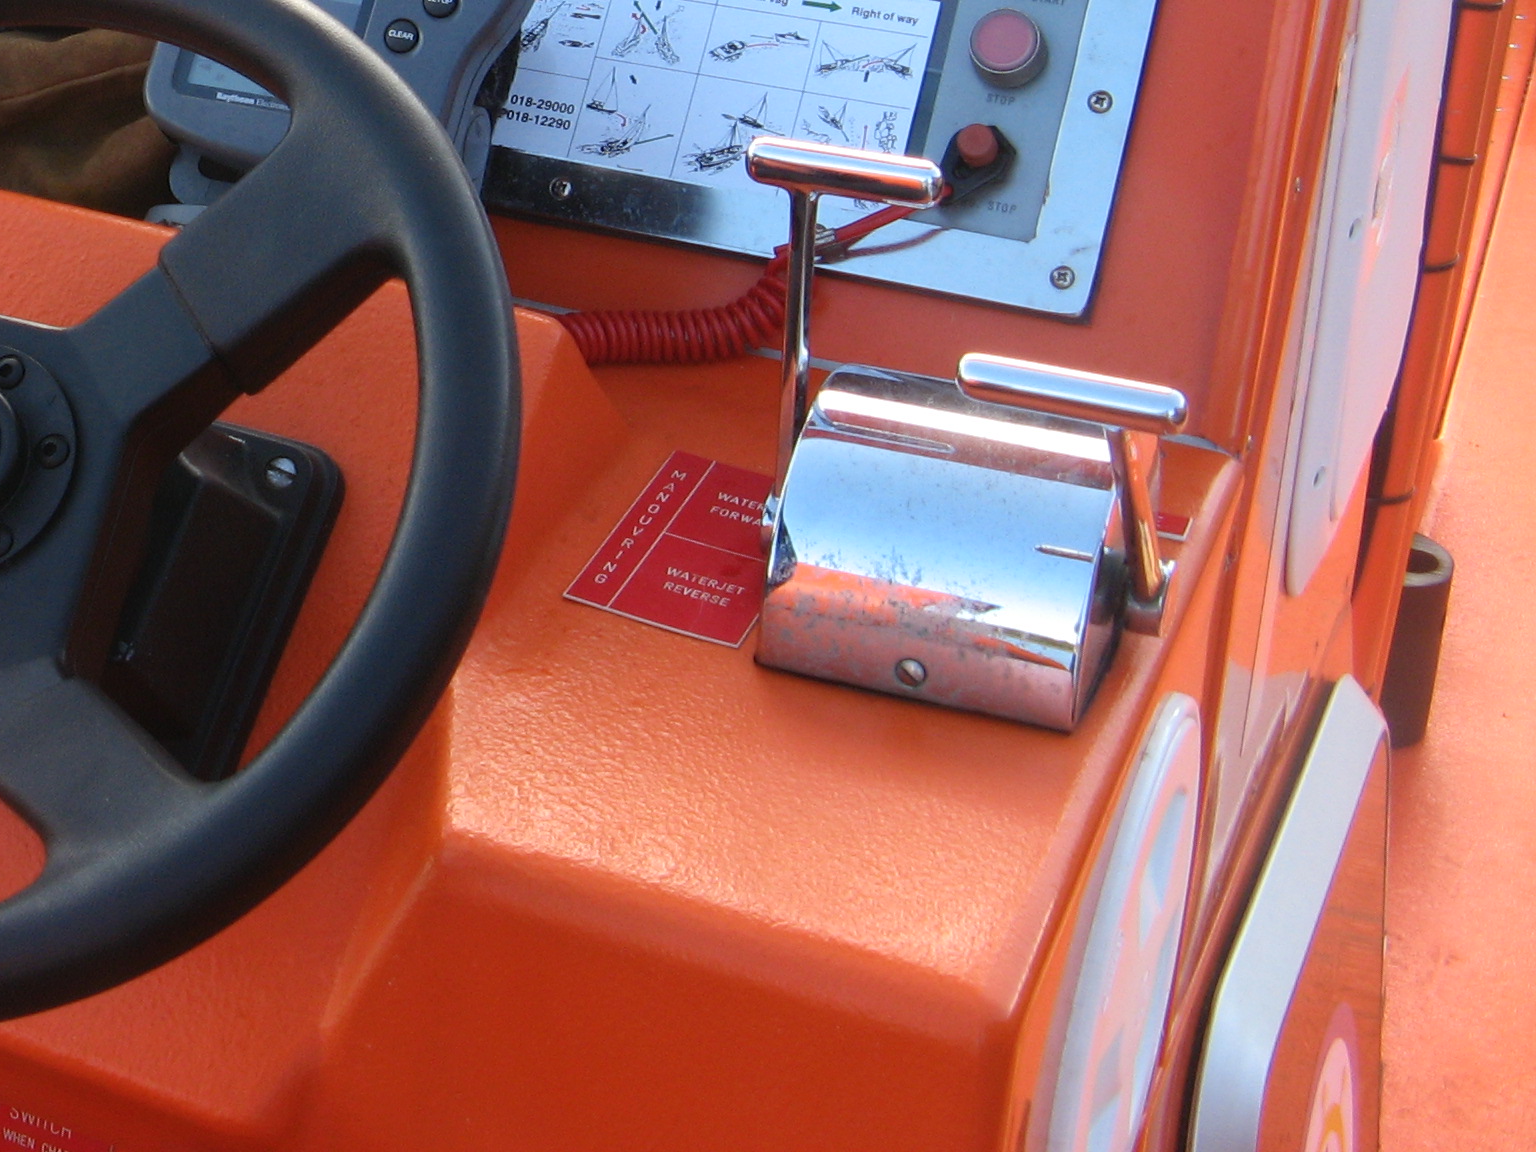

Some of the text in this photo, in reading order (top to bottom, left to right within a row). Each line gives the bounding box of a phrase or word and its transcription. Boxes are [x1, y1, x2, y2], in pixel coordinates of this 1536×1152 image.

[852, 6, 919, 26] Right of way
[388, 29, 415, 41] CLEAR
[510, 94, 575, 115] 018-29000
[986, 93, 1016, 106] STOP
[506, 110, 571, 130] 018-12290
[987, 200, 1017, 214] STOP
[718, 492, 766, 511] WATER
[710, 505, 762, 527] FORWA
[594, 470, 687, 584] MANOUVRING
[666, 567, 745, 595] WATERJET
[663, 581, 731, 607] REVERSE
[3, 1126, 35, 1150] WHEN
